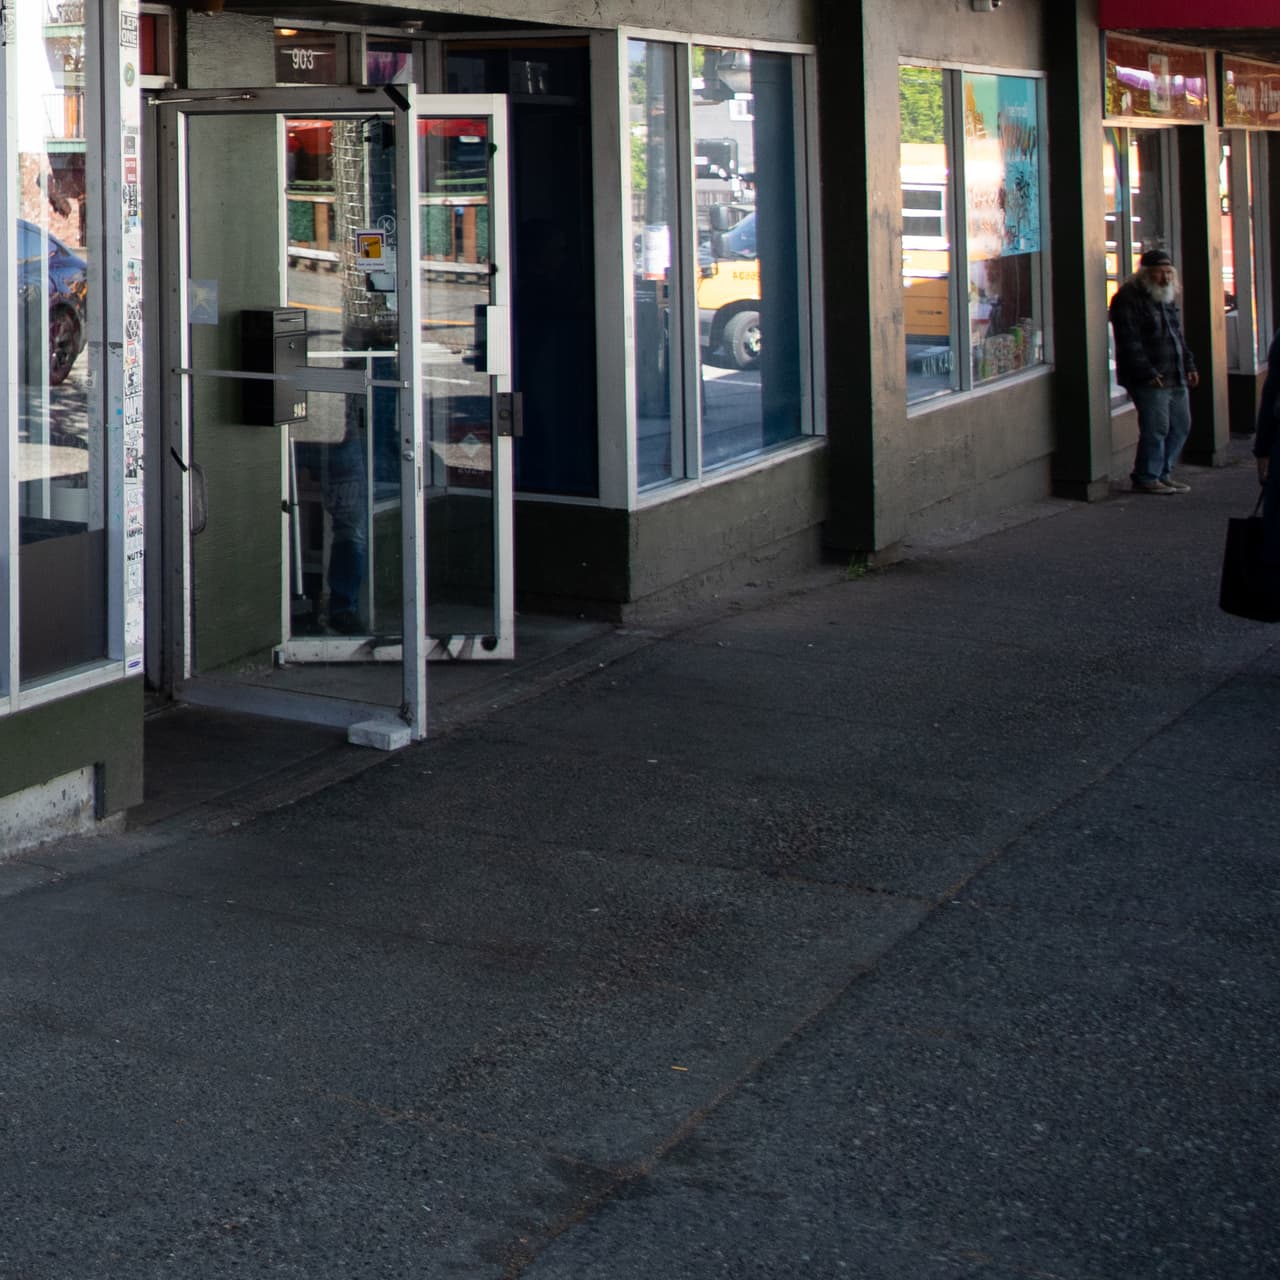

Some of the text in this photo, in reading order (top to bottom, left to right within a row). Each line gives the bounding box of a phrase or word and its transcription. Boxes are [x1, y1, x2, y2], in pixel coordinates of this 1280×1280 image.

[292, 48, 314, 70] 903
[293, 401, 306, 417] 903
[126, 550, 143, 562] NUTS
